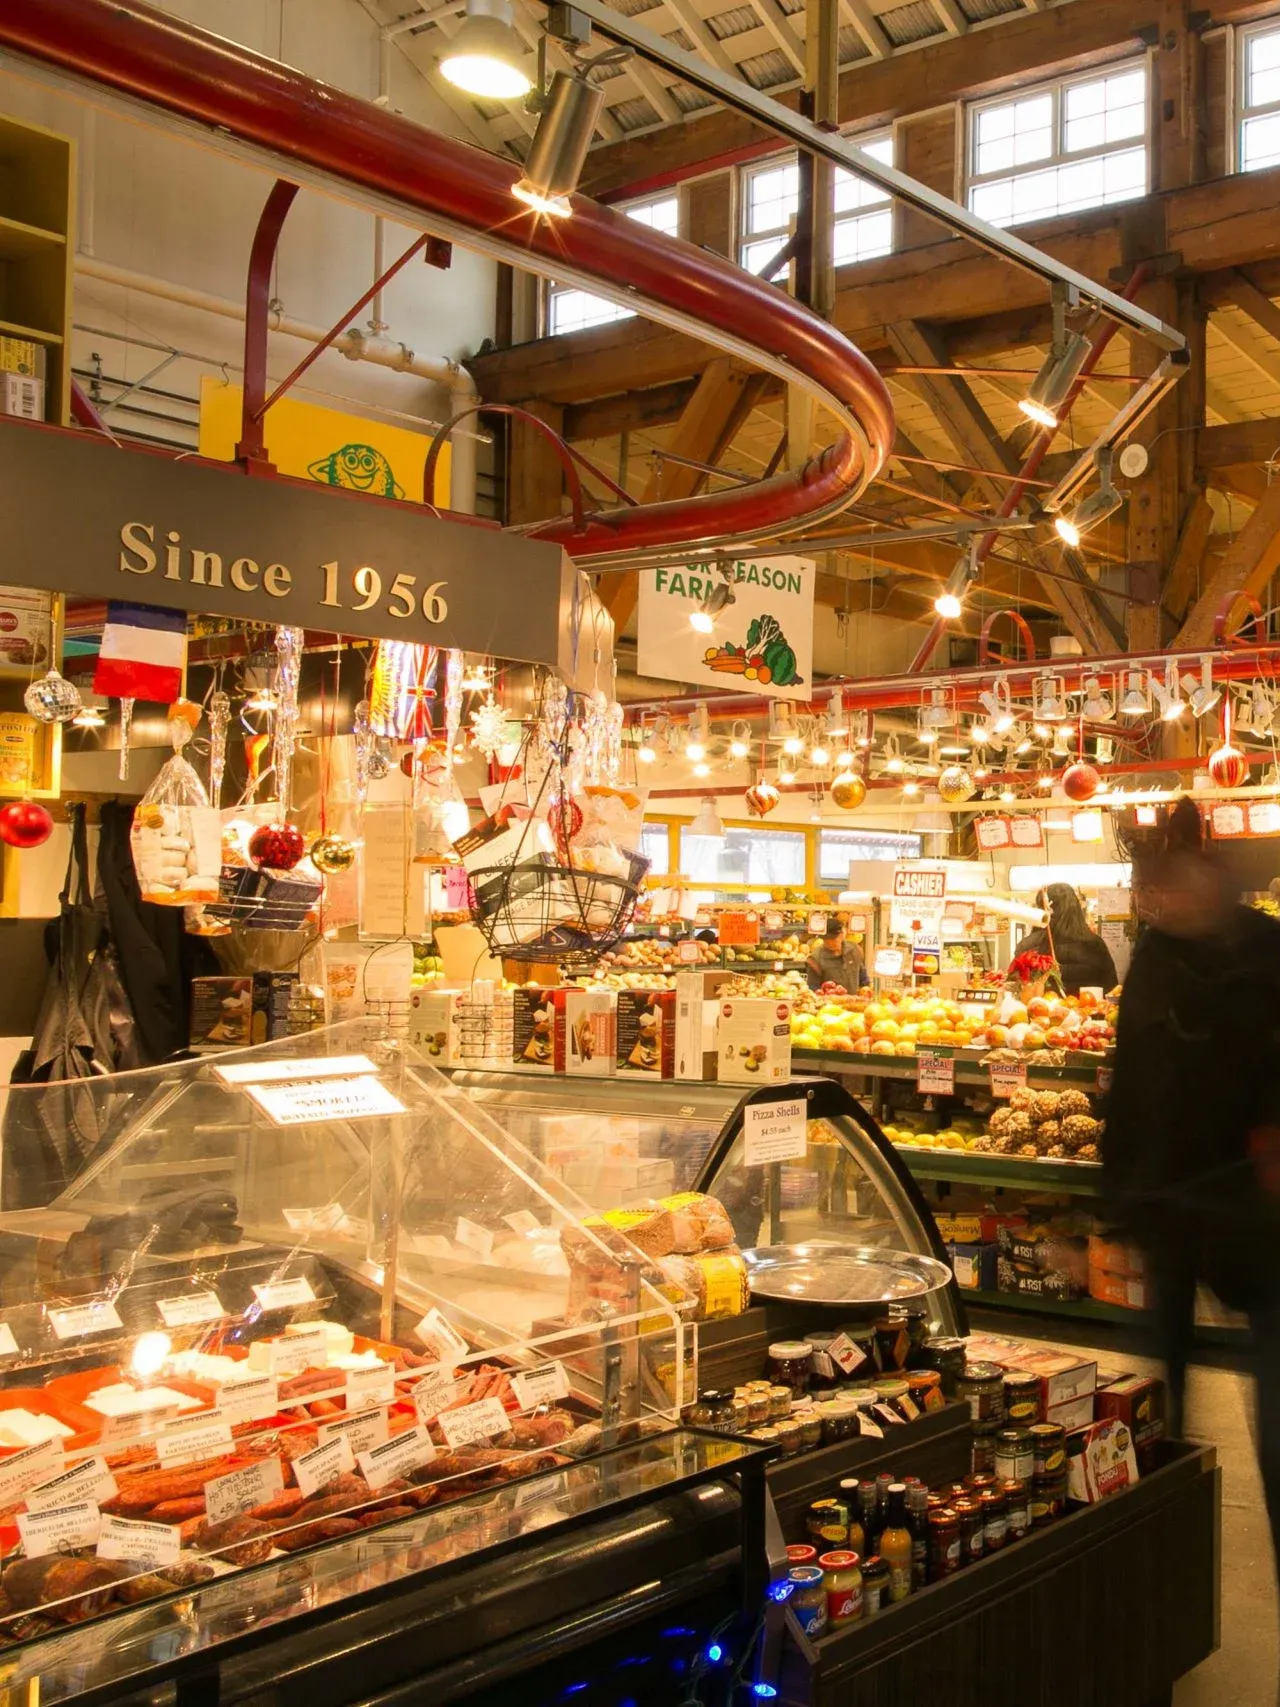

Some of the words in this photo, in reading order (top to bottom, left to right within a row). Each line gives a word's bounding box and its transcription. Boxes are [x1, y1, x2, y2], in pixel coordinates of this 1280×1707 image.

[119, 521, 292, 598] Since
[319, 560, 450, 624] 1956
[722, 560, 802, 594] EASON
[896, 872, 944, 896] CASHIER
[917, 935, 938, 945] VISA
[752, 1110, 775, 1121] Pizza
[776, 1105, 800, 1118] Shells
